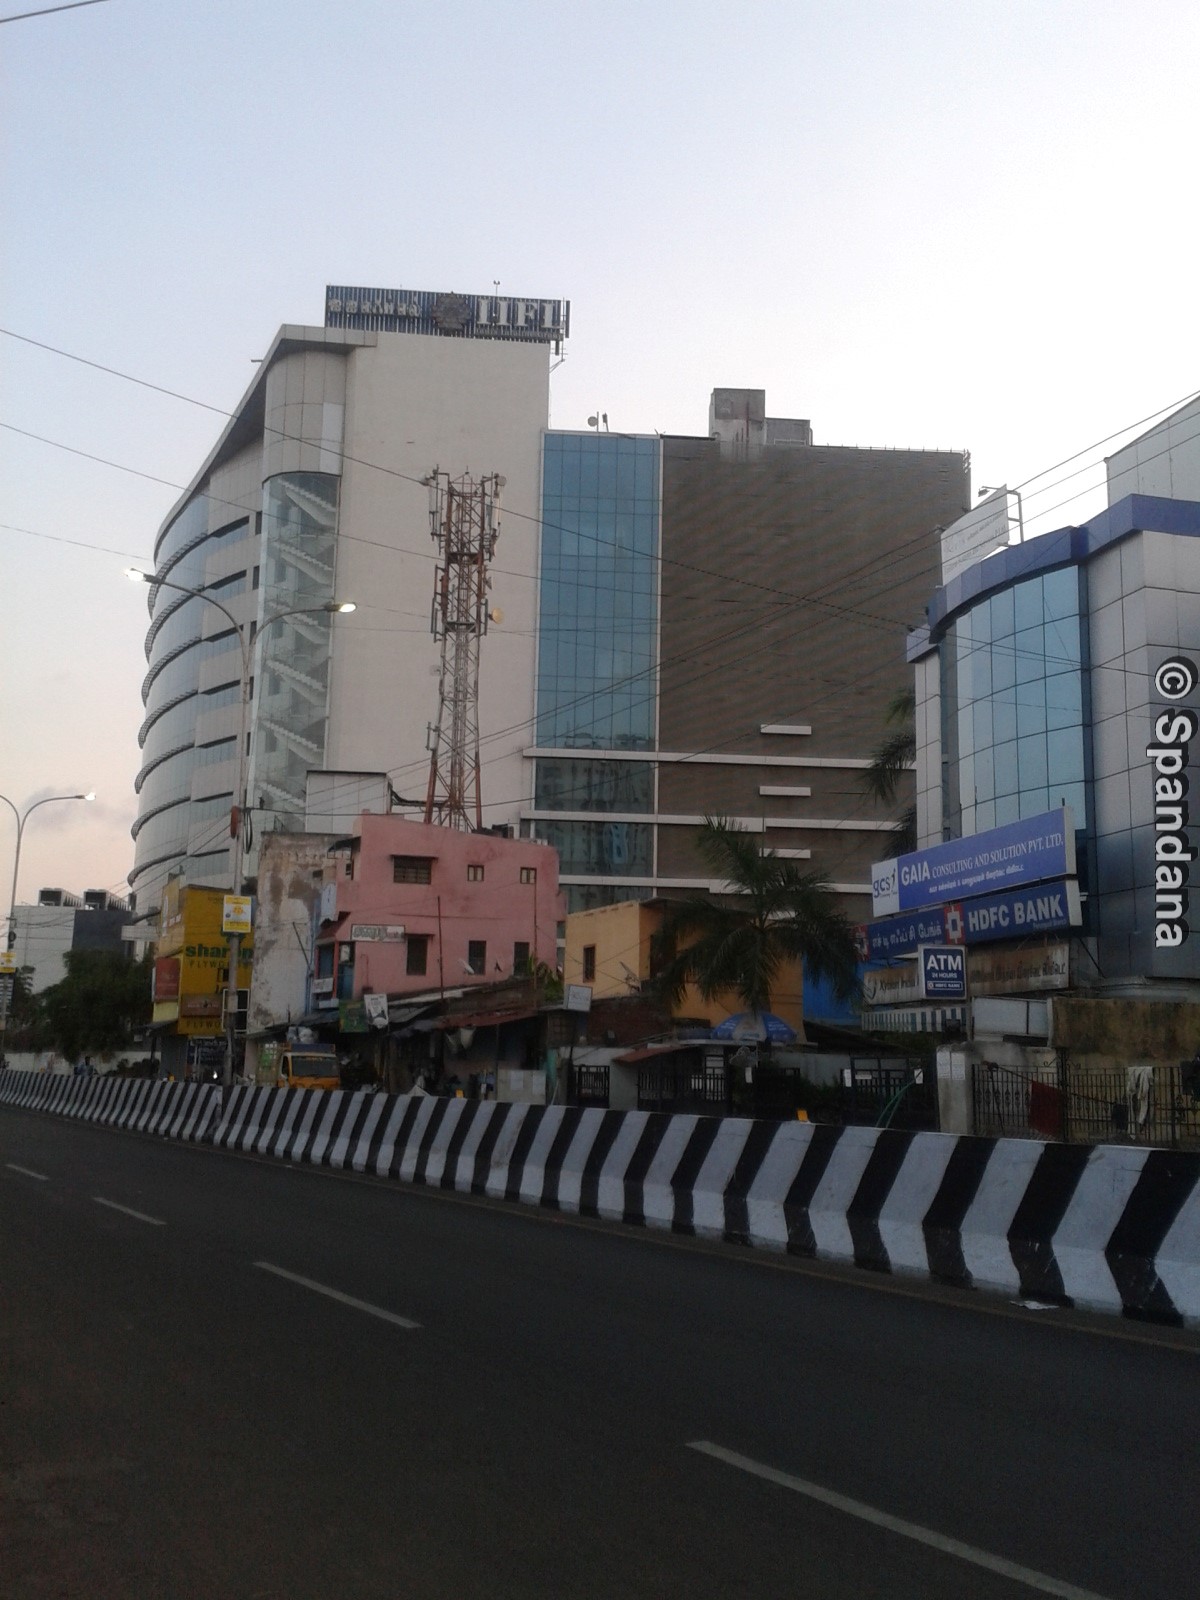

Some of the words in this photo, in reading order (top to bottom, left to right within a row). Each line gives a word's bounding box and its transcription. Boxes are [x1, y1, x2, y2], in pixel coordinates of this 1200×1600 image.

[476, 298, 564, 329] IIFL
[901, 861, 931, 886] GAIA
[931, 857, 974, 879] CONSULTING
[974, 853, 990, 869] AND
[989, 843, 1028, 864] SOLUTION
[1028, 838, 1045, 854] PVT.
[968, 904, 1010, 932] HDFC
[1013, 894, 1064, 925] BANK
[927, 954, 962, 971] ATM
